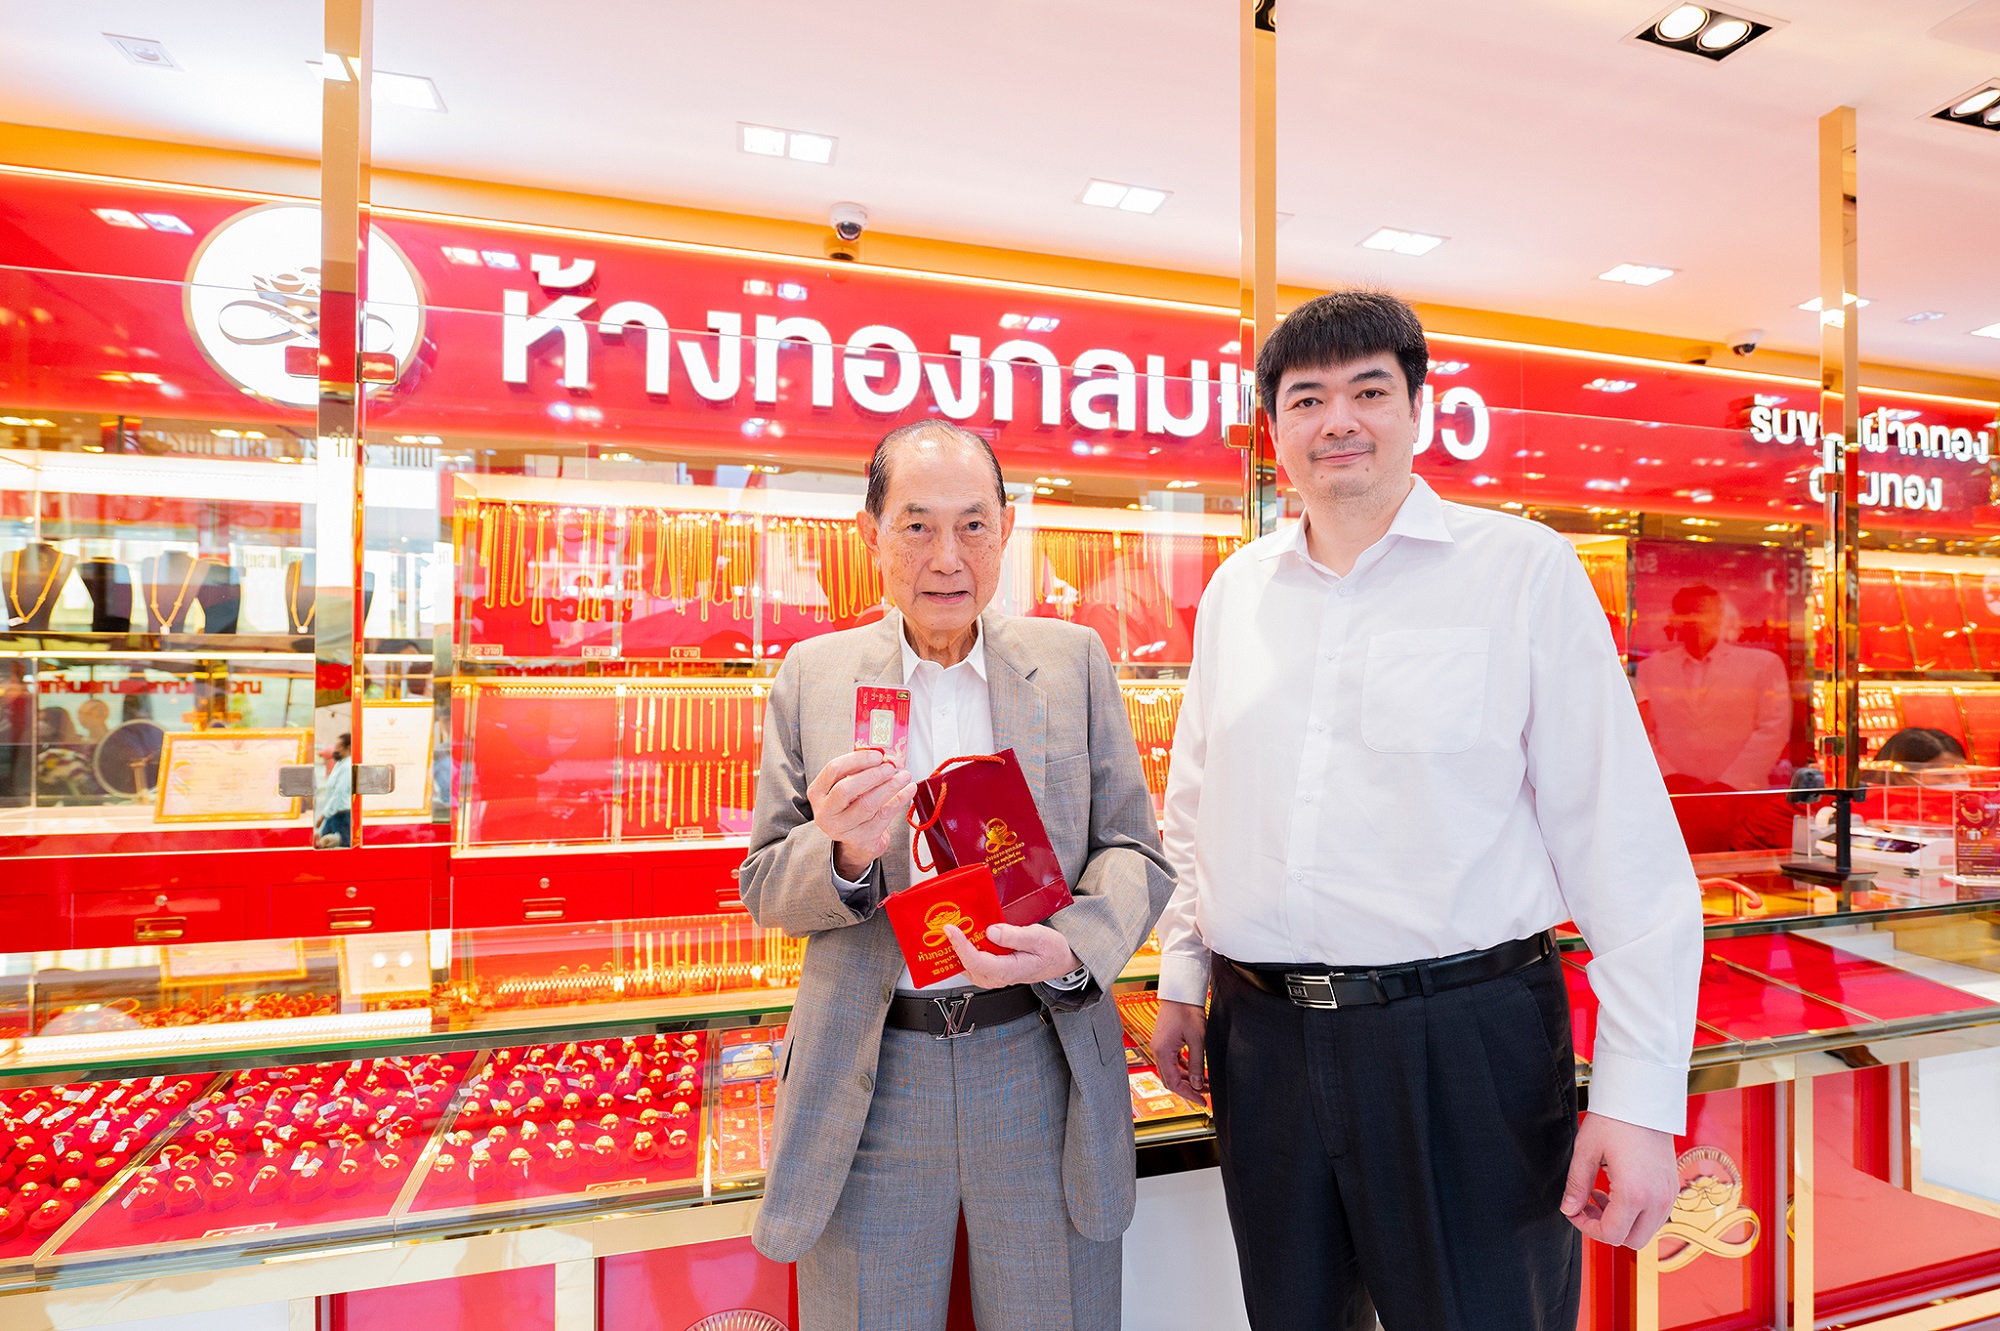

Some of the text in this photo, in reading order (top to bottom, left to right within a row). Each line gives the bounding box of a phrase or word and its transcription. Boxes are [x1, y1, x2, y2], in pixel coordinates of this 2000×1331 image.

[503, 253, 1490, 462] ห้างทองกลมเว
[1750, 394, 1990, 464] รับขฝากทอง
